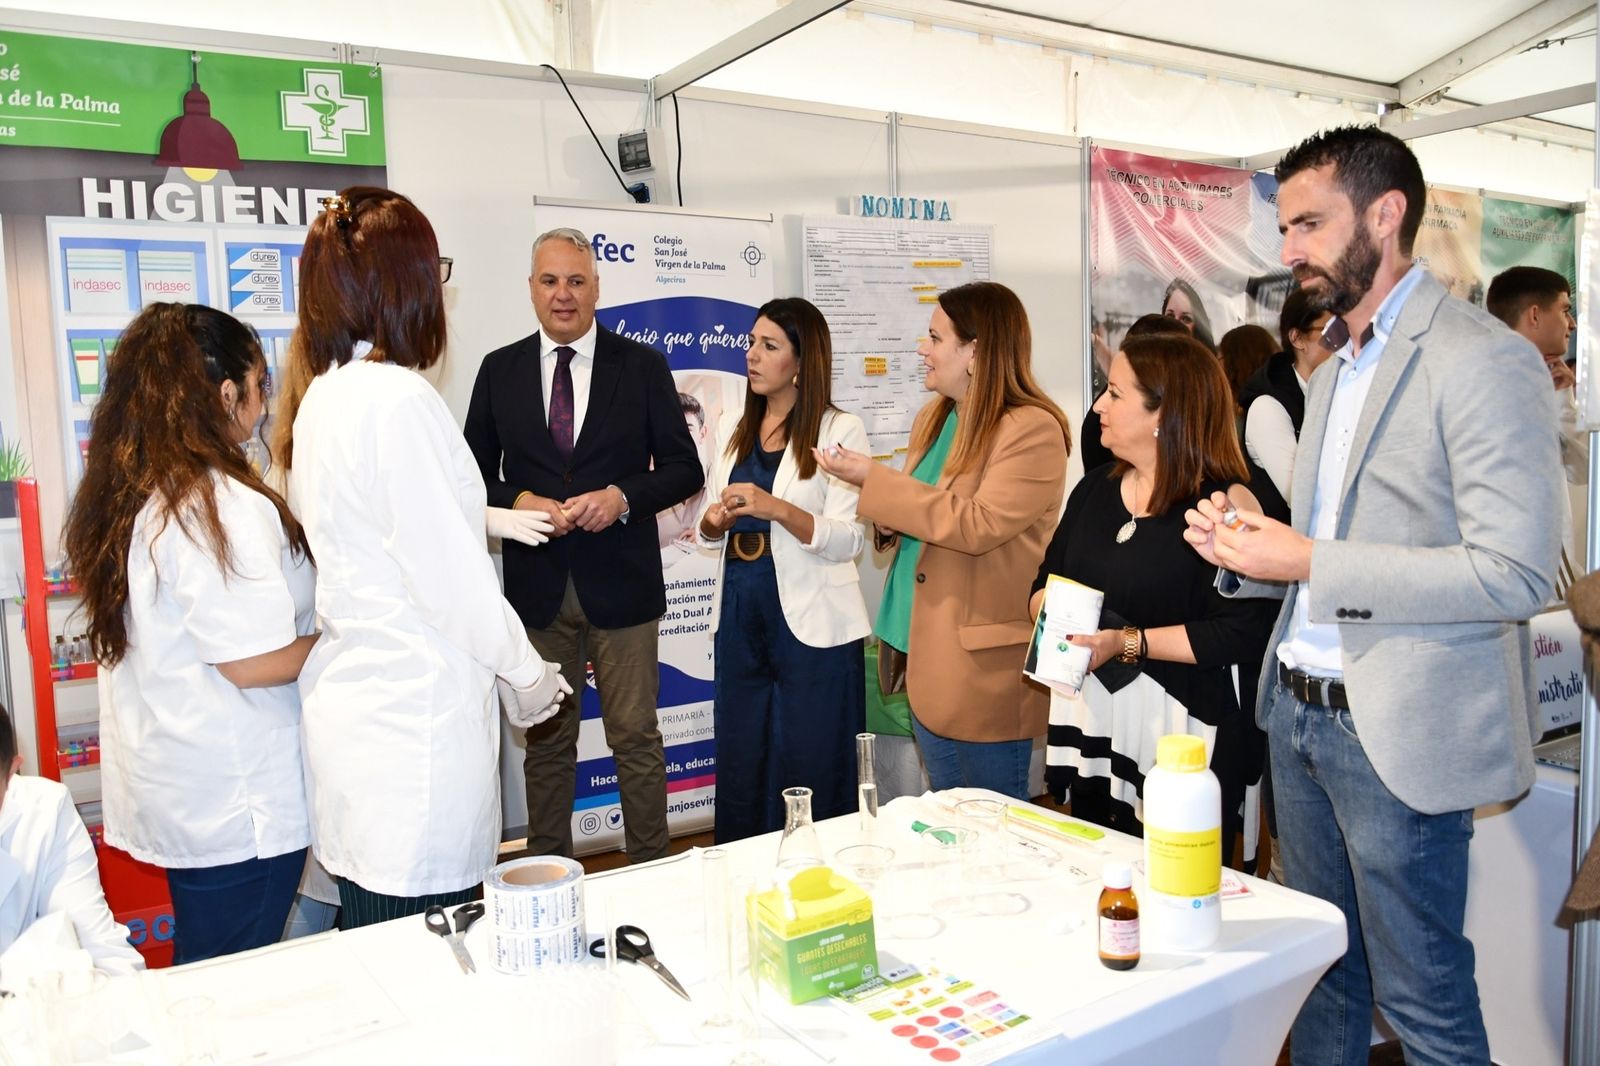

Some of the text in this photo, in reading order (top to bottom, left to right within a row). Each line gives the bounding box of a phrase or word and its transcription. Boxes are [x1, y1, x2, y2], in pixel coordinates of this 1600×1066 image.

[8, 89, 31, 107] de
[36, 90, 54, 109] la
[60, 92, 121, 114] Palma
[1152, 176, 1165, 189] EN
[1132, 191, 1204, 212] COMERCIALES
[861, 194, 952, 222] NOMINA
[653, 235, 683, 247] Colegio
[591, 233, 635, 263] fec
[654, 247, 688, 257] San José
[252, 252, 278, 262] durex
[655, 259, 726, 271] Virgen de la Palma
[73, 279, 121, 291] indasec
[252, 274, 280, 284] durex
[655, 275, 686, 285] Algeciras
[144, 280, 191, 292] indasec
[253, 295, 281, 304] durex
[664, 332, 695, 354] que
[666, 594, 696, 606] vación
[683, 607, 704, 619] Dual
[658, 622, 710, 637] creditación
[707, 652, 713, 660] y
[662, 710, 705, 725] PRIMARIA
[664, 729, 695, 741] privado
[665, 761, 684, 773] ela,
[590, 775, 618, 787] Hace
